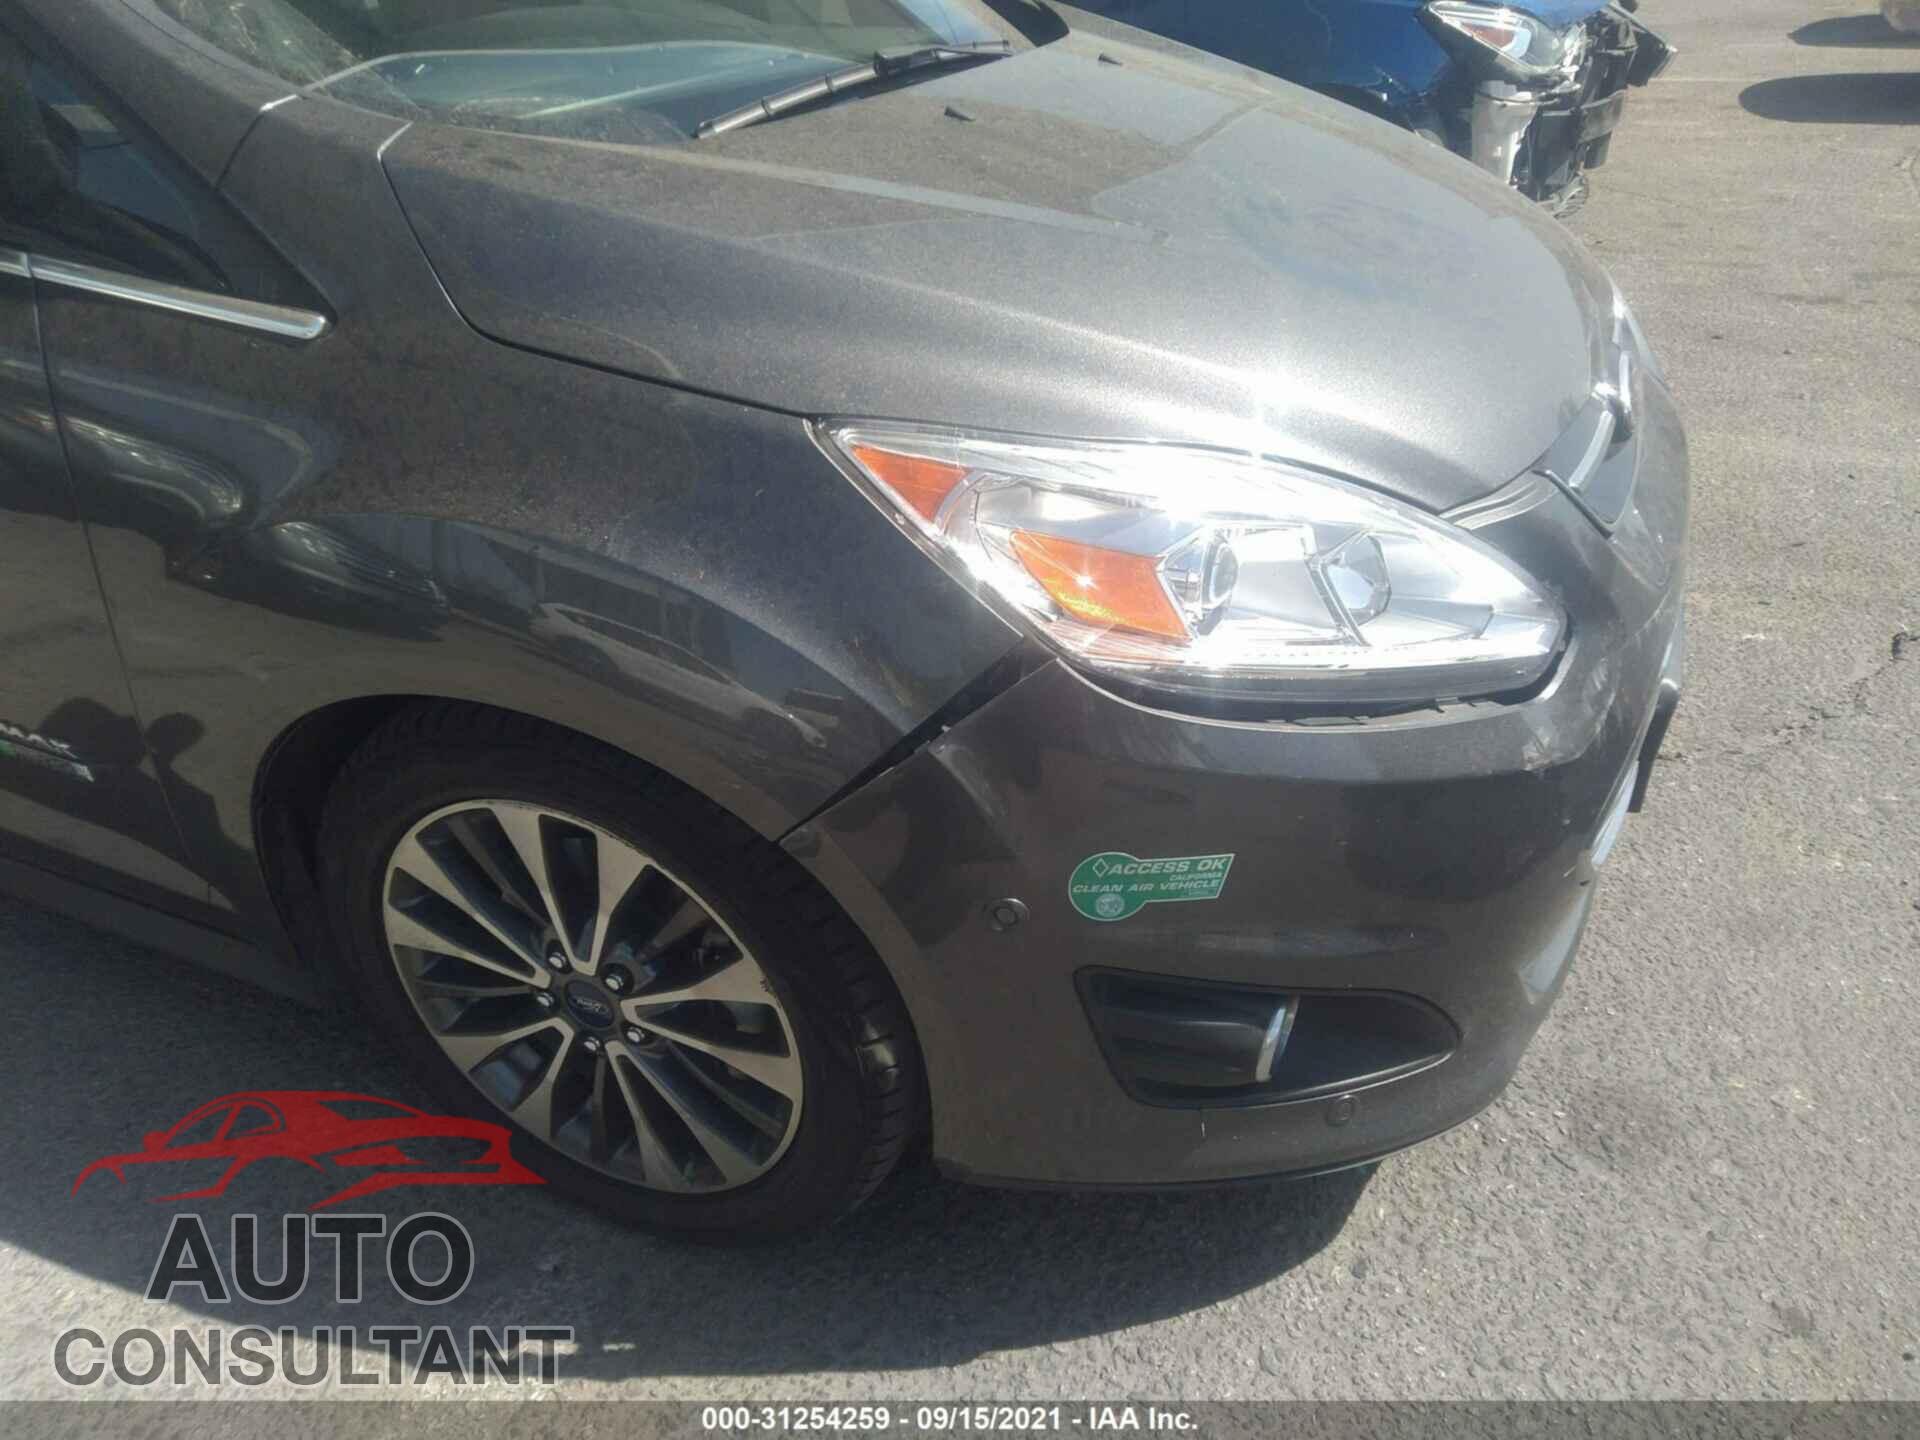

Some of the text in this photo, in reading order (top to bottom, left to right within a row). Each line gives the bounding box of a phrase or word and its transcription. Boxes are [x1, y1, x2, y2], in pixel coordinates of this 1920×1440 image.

[1108, 858, 1227, 875] ACCESS OK
[1072, 879, 1220, 893] CLEAN AIR VEHICLE
